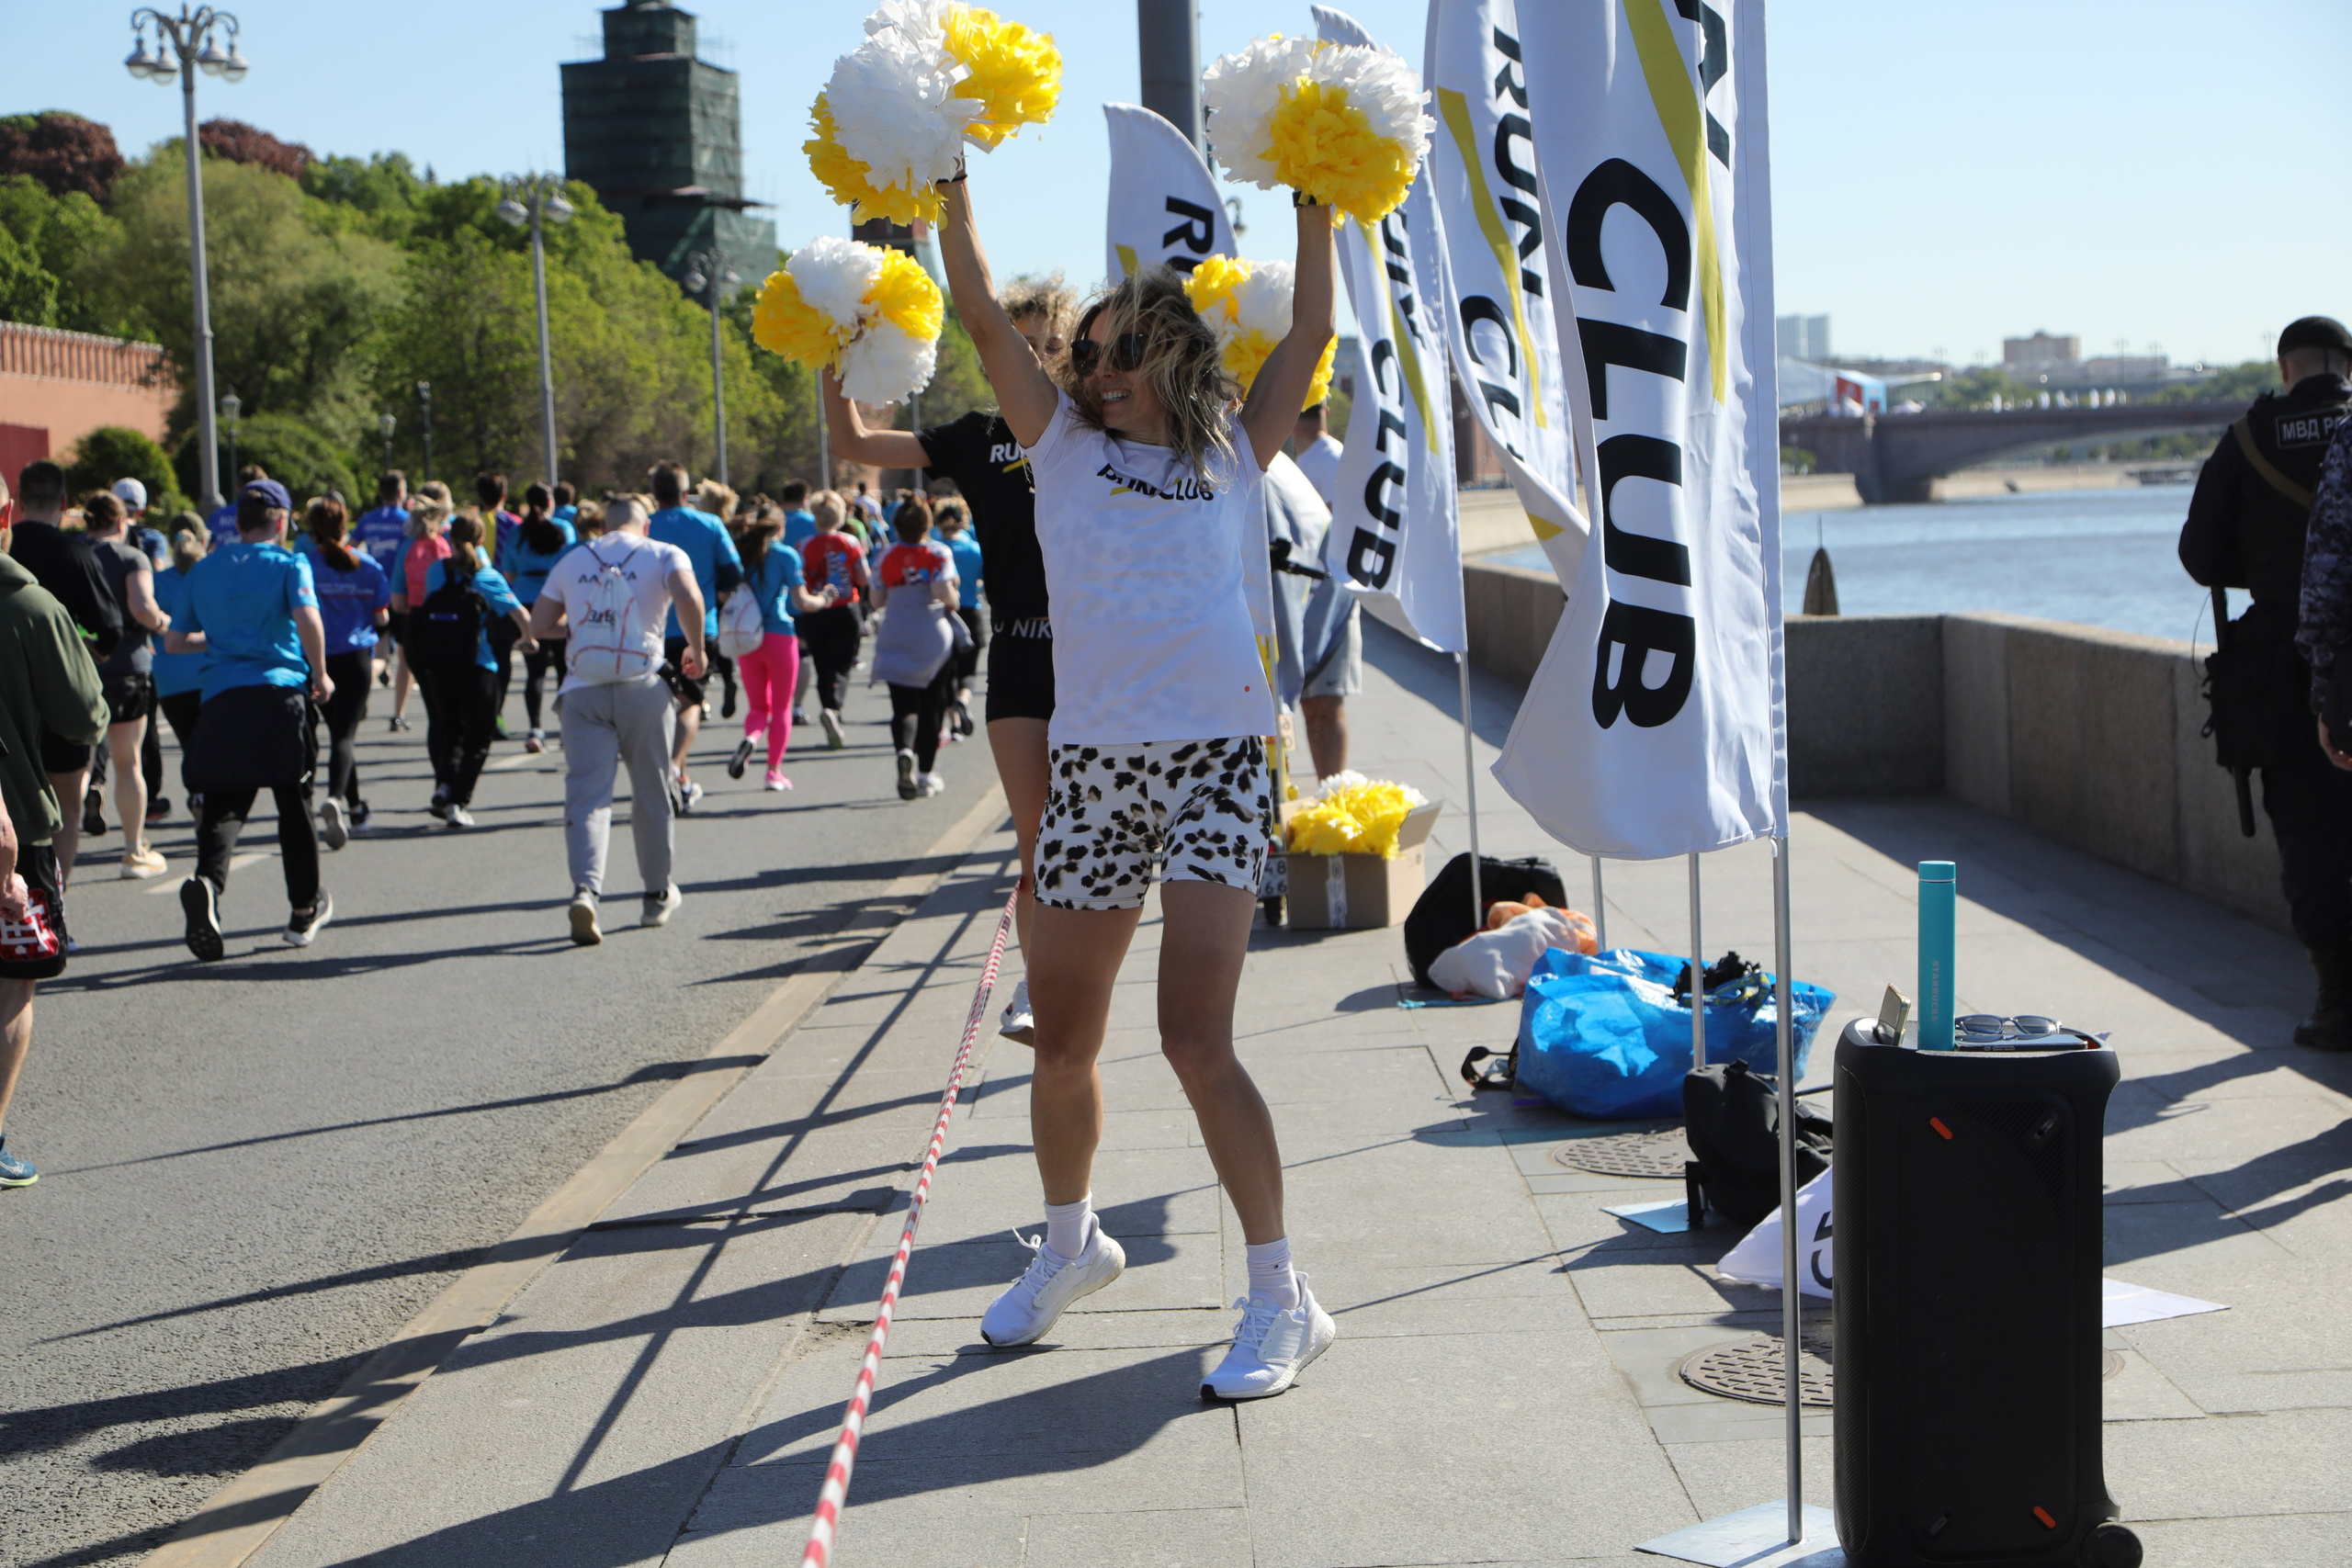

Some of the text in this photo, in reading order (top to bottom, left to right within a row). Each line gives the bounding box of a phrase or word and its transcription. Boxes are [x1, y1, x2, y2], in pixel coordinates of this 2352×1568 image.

[1460, 296, 1524, 462] CL
[2282, 417, 2321, 441] МВД
[989, 442, 1026, 464] RU
[1348, 339, 1407, 591] CLUB
[1566, 158, 1696, 729] CLUB
[1931, 960, 1939, 1021] STARBUCKS
